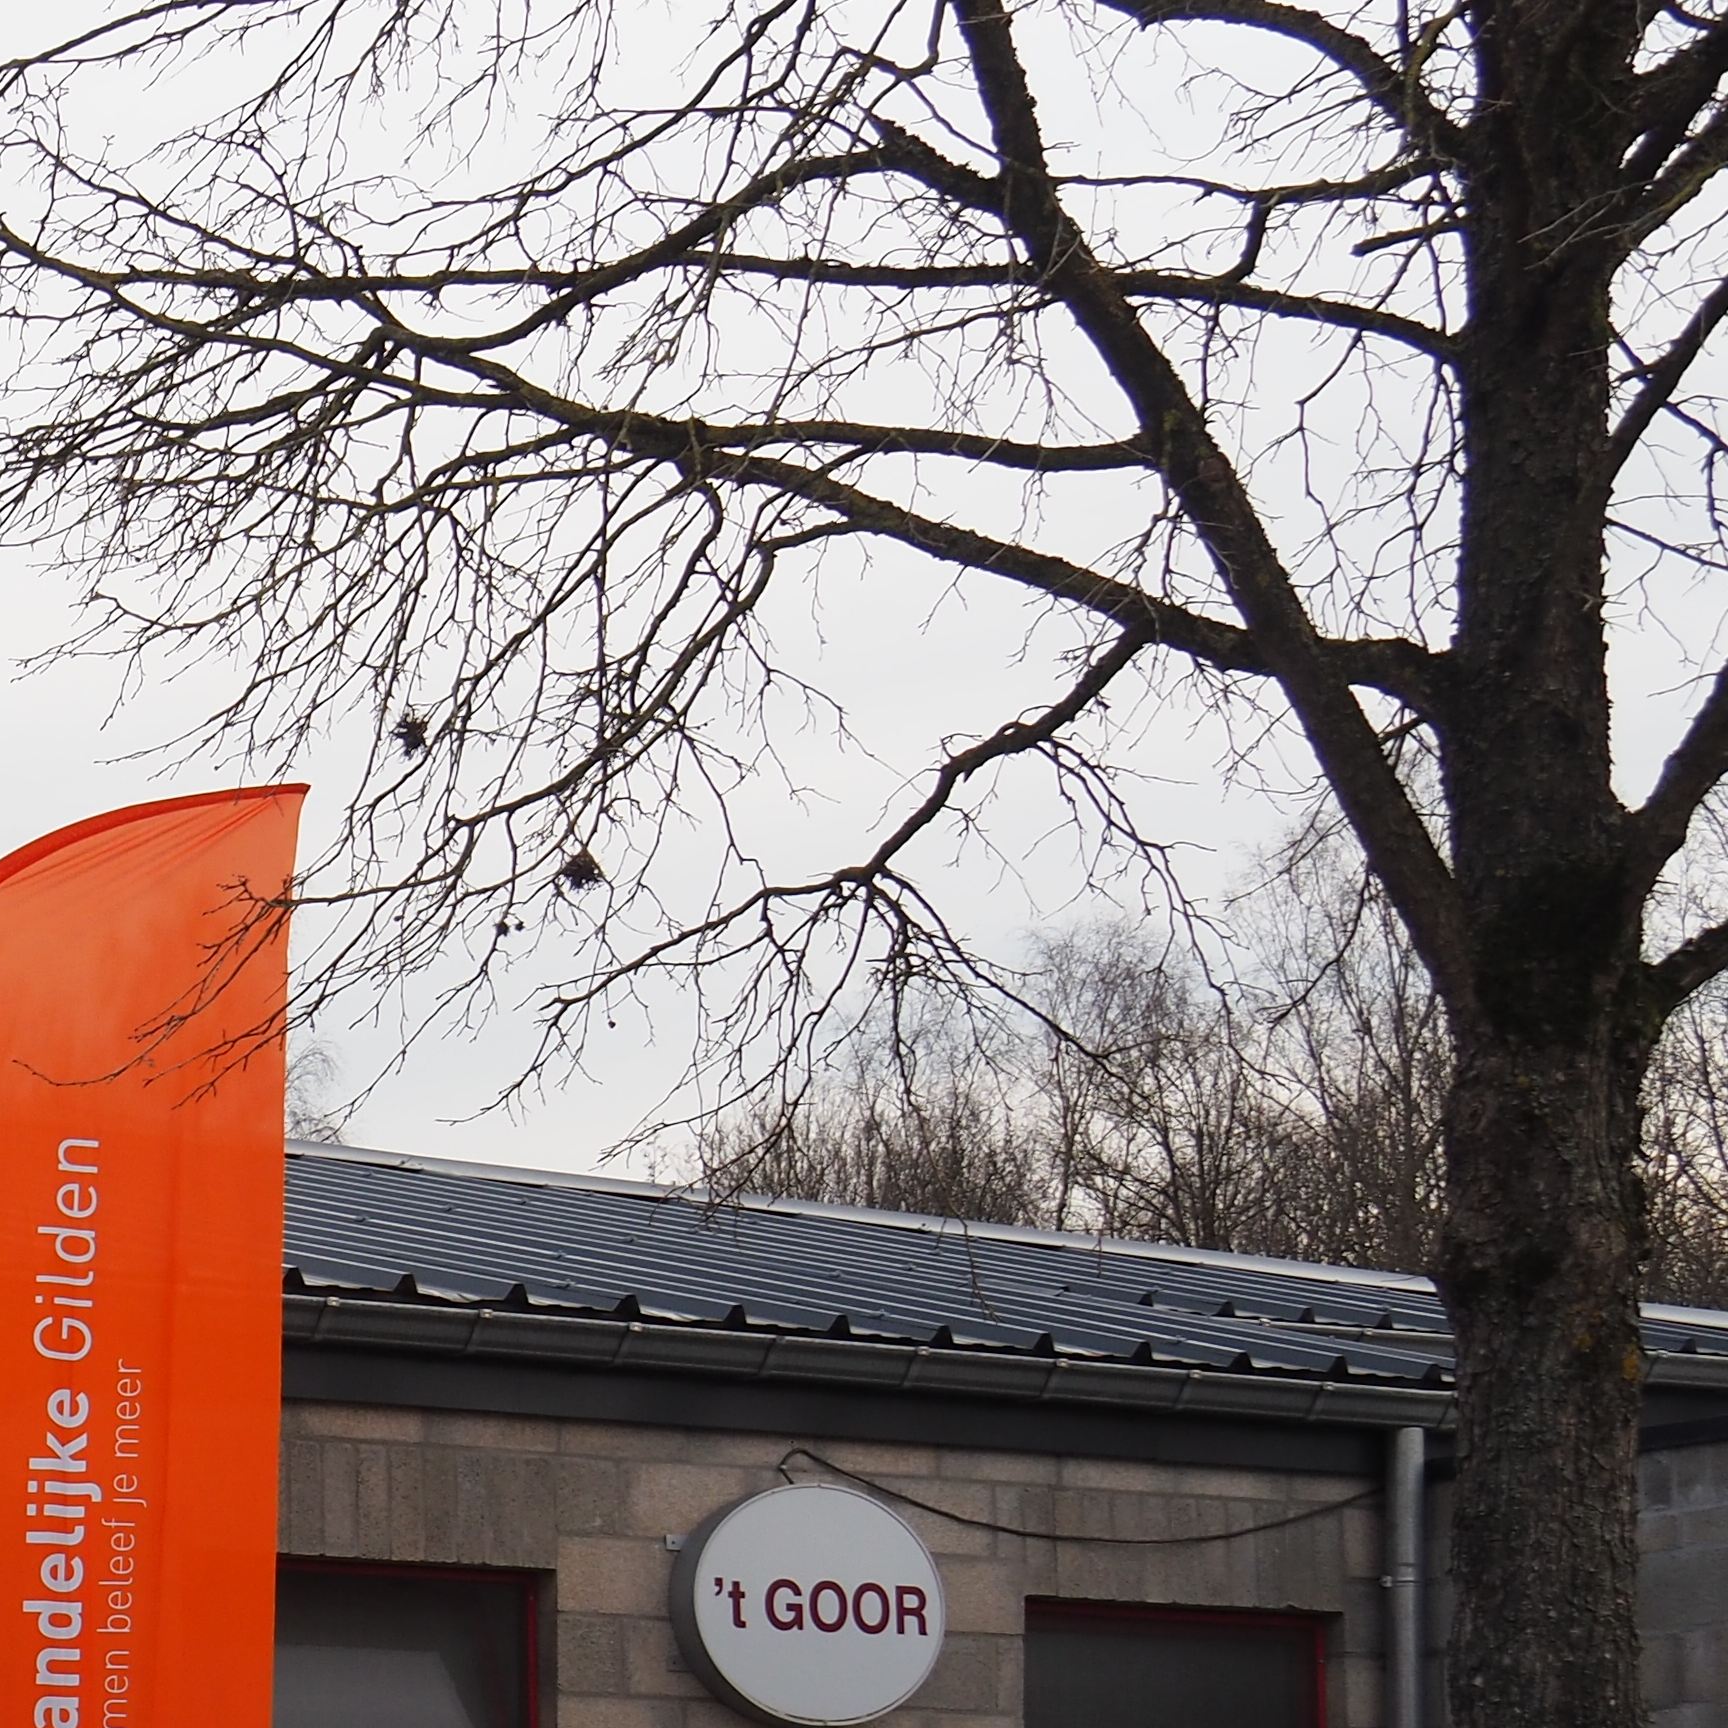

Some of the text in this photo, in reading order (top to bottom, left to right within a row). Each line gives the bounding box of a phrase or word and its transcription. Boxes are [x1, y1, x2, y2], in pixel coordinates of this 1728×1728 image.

[34, 1139, 99, 1361] Gilden
[115, 1360, 142, 1457] meer
[107, 1475, 146, 1507] je
[97, 1519, 134, 1632] beleef
[765, 1579, 929, 1636] GOOR
